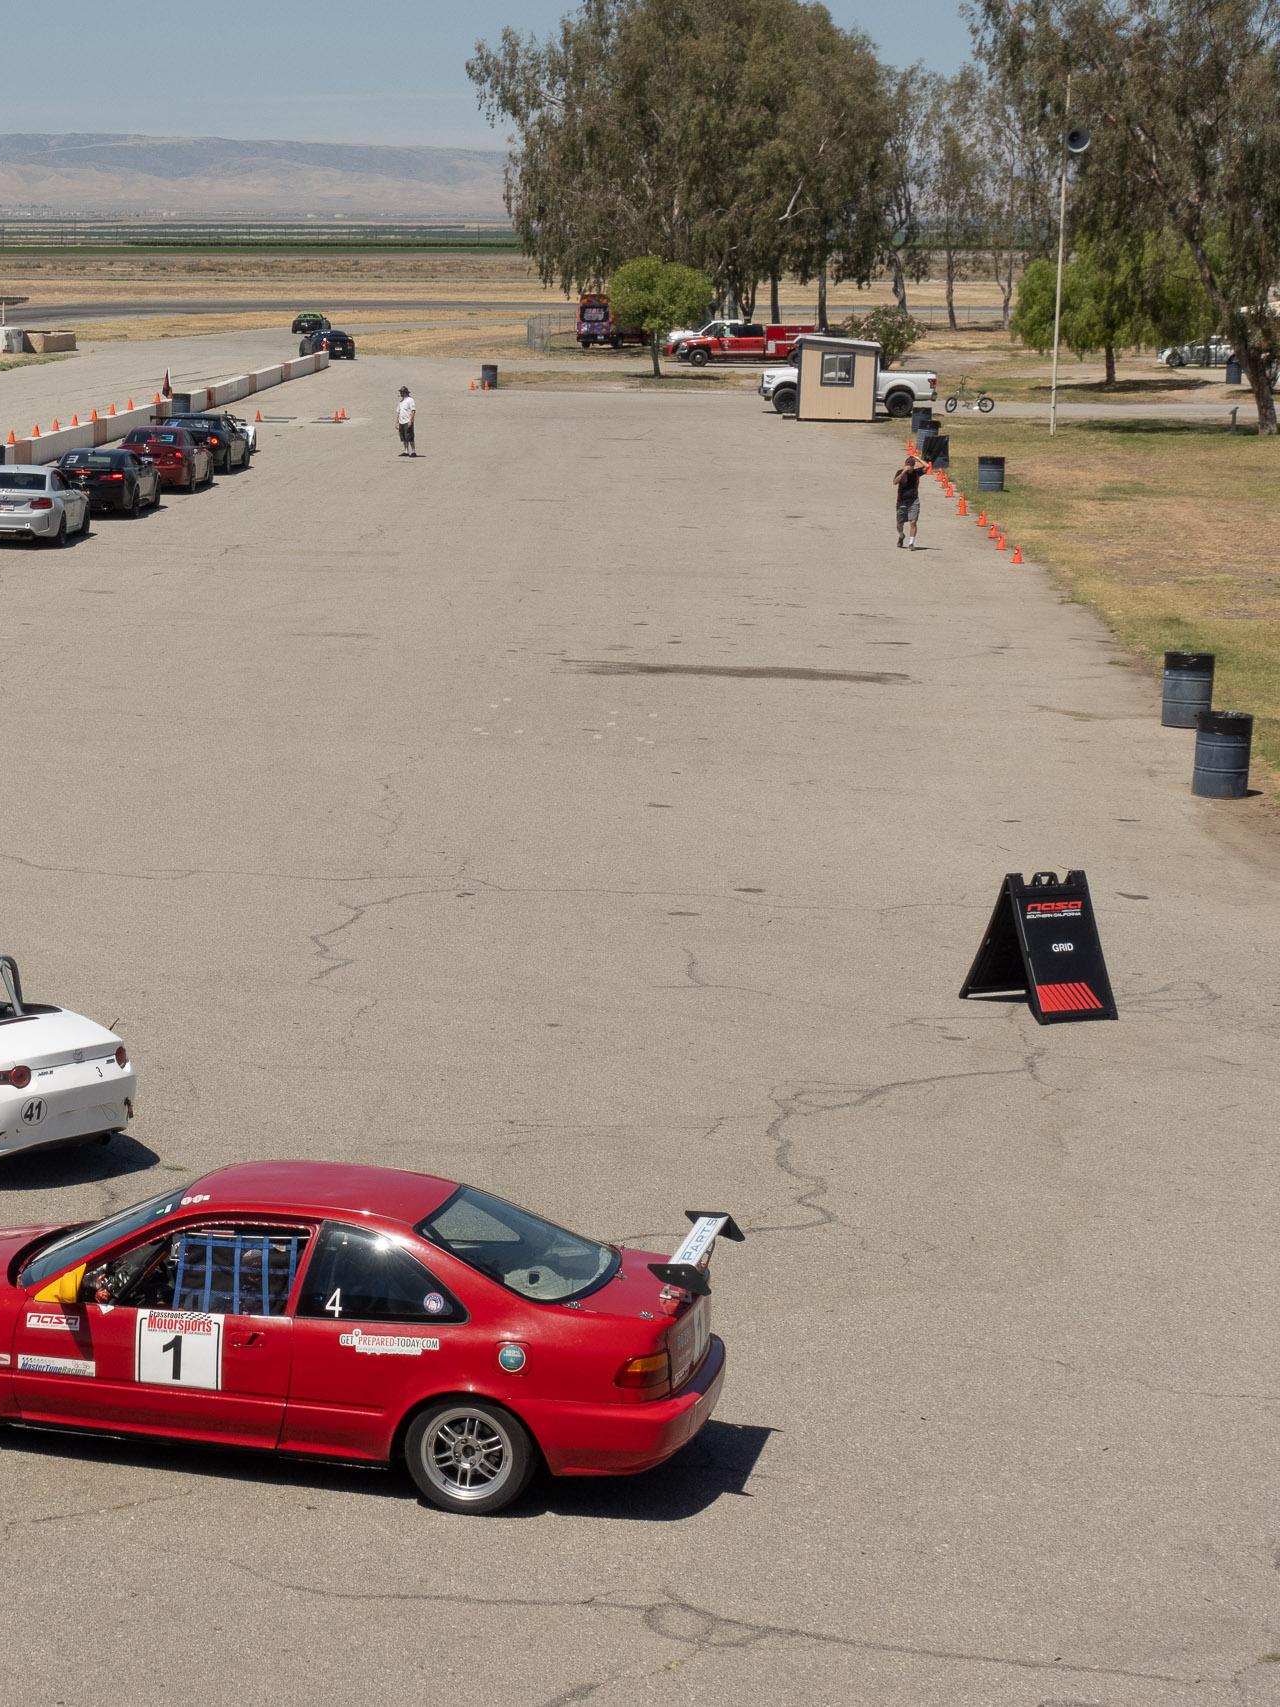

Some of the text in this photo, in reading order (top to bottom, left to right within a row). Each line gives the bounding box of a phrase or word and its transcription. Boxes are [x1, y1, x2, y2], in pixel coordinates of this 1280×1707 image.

[1027, 901, 1082, 912] nasa
[1052, 943, 1074, 953] GRID
[23, 1101, 42, 1122] 41
[682, 1218, 718, 1262] PARTS
[325, 1287, 343, 1318] 4
[27, 1314, 79, 1326] nasa
[148, 1310, 185, 1319] Grassroots
[147, 1317, 212, 1334] Motorsports
[162, 1334, 183, 1381] 1
